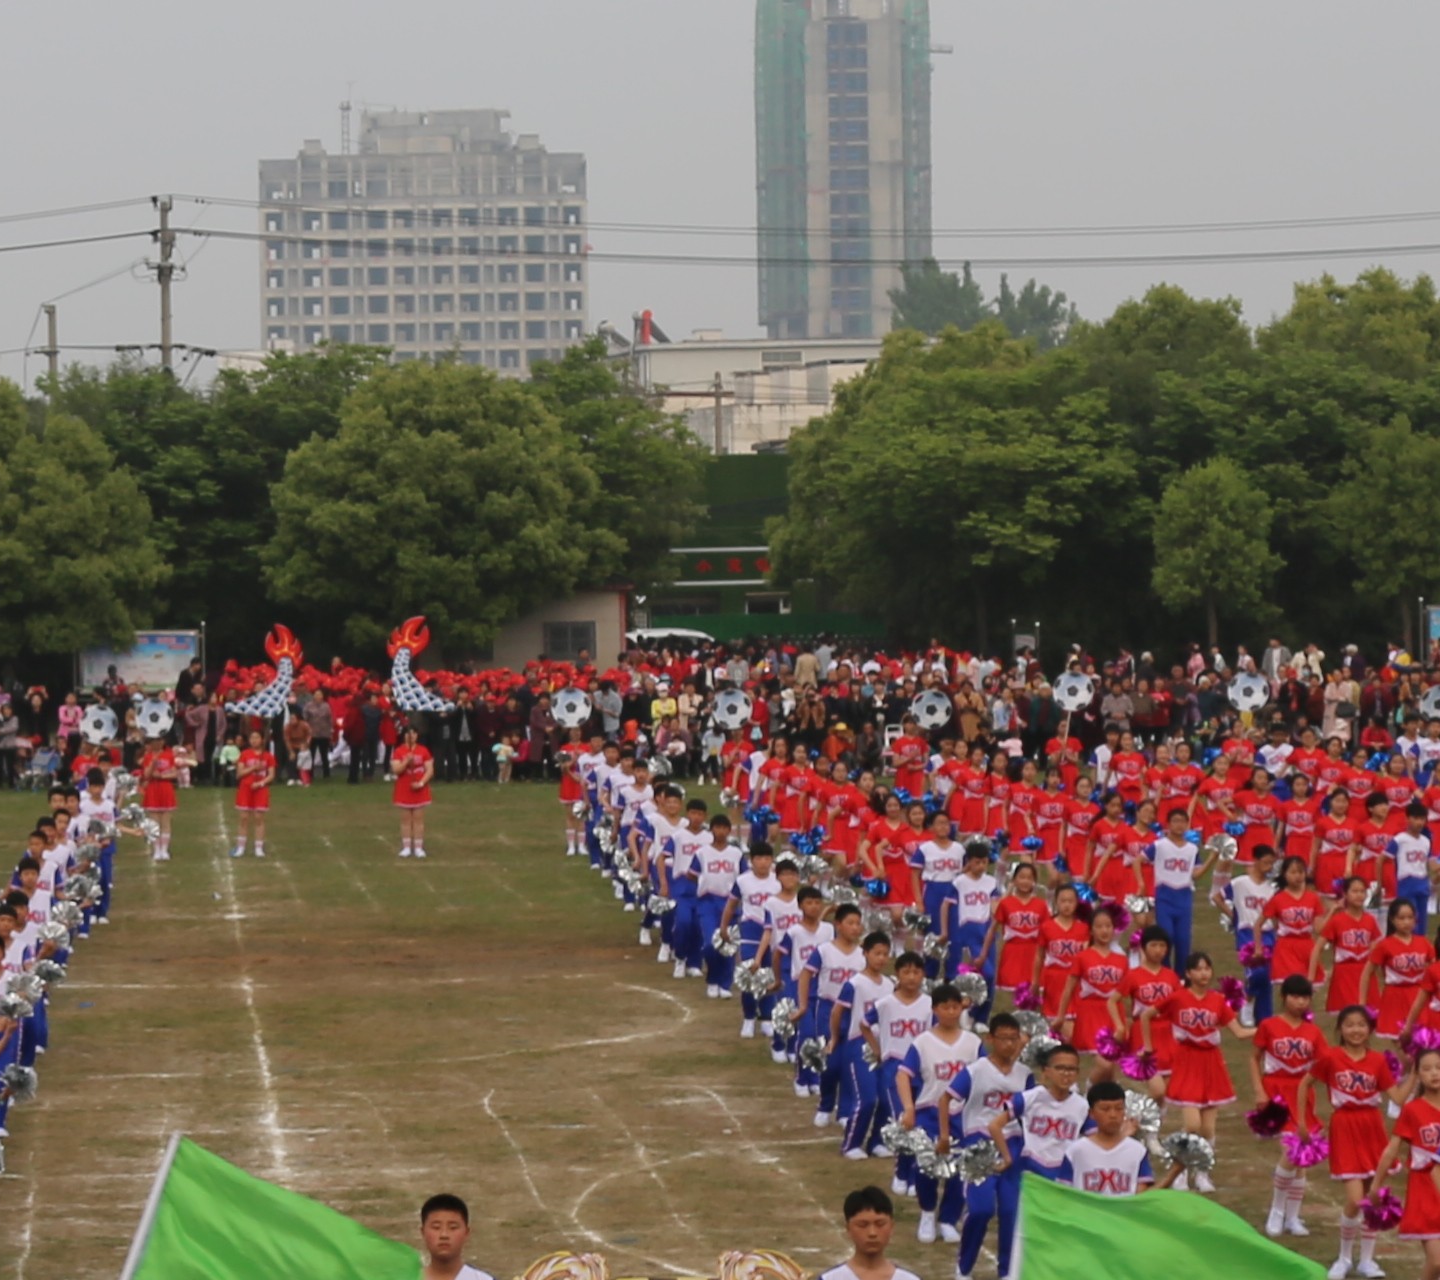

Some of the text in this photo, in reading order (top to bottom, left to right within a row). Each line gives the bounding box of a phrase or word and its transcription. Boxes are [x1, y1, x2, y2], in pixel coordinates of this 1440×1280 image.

[1049, 940, 1086, 957] CXU
[1392, 953, 1430, 971] CXU
[1179, 1009, 1217, 1028] CXU
[1274, 1039, 1314, 1058] CXU
[1336, 1071, 1377, 1091] CXU
[1029, 1116, 1076, 1138] CXU
[1083, 1170, 1131, 1192] CXU
